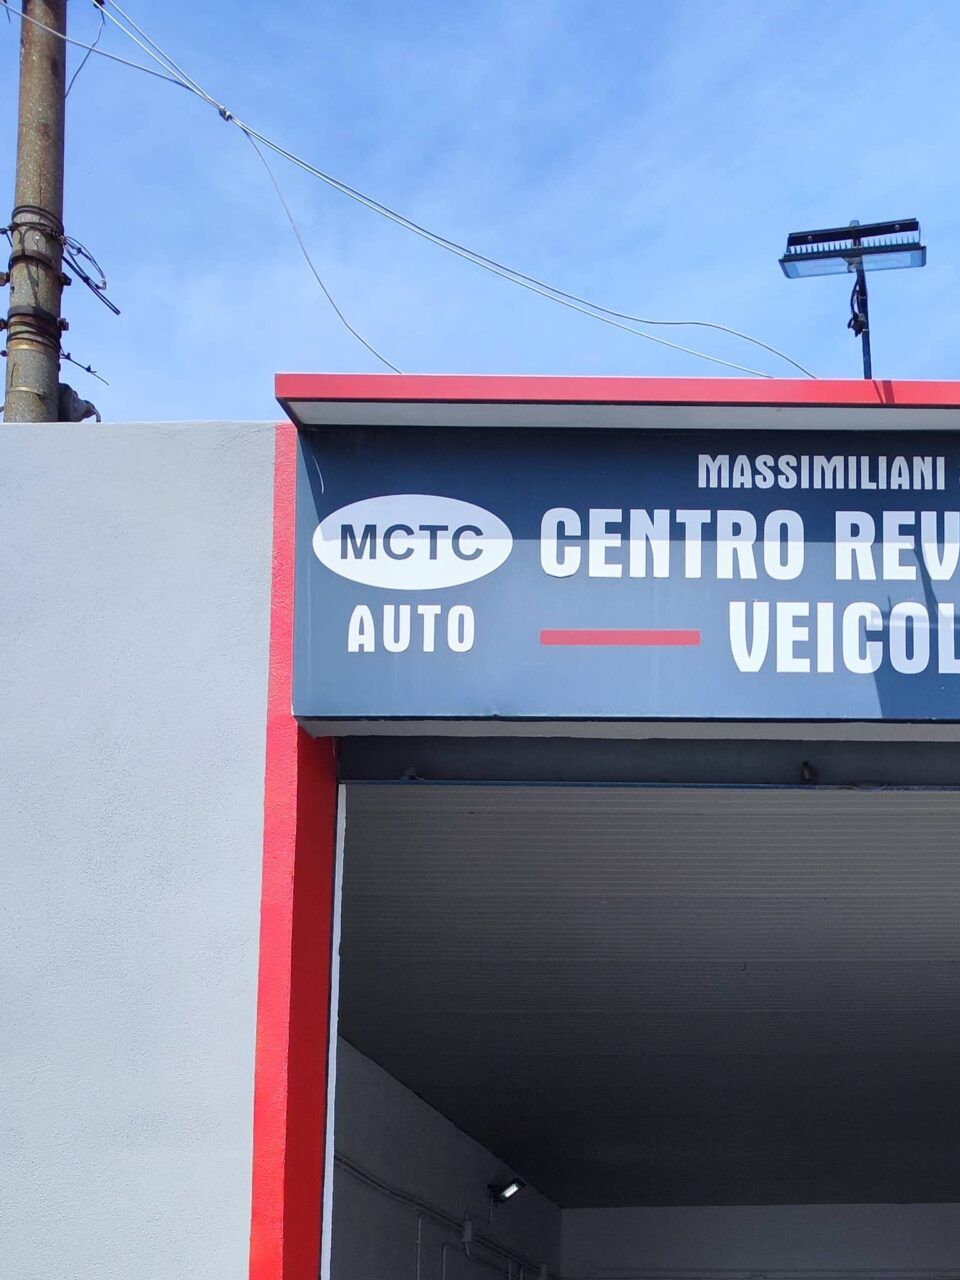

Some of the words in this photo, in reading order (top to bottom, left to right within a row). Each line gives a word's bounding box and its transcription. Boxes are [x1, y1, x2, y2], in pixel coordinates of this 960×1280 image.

[697, 453, 946, 492] MASSIMILIANI
[339, 523, 485, 561] MCTC
[540, 507, 805, 581] CENTRO
[347, 604, 475, 653] AUTO
